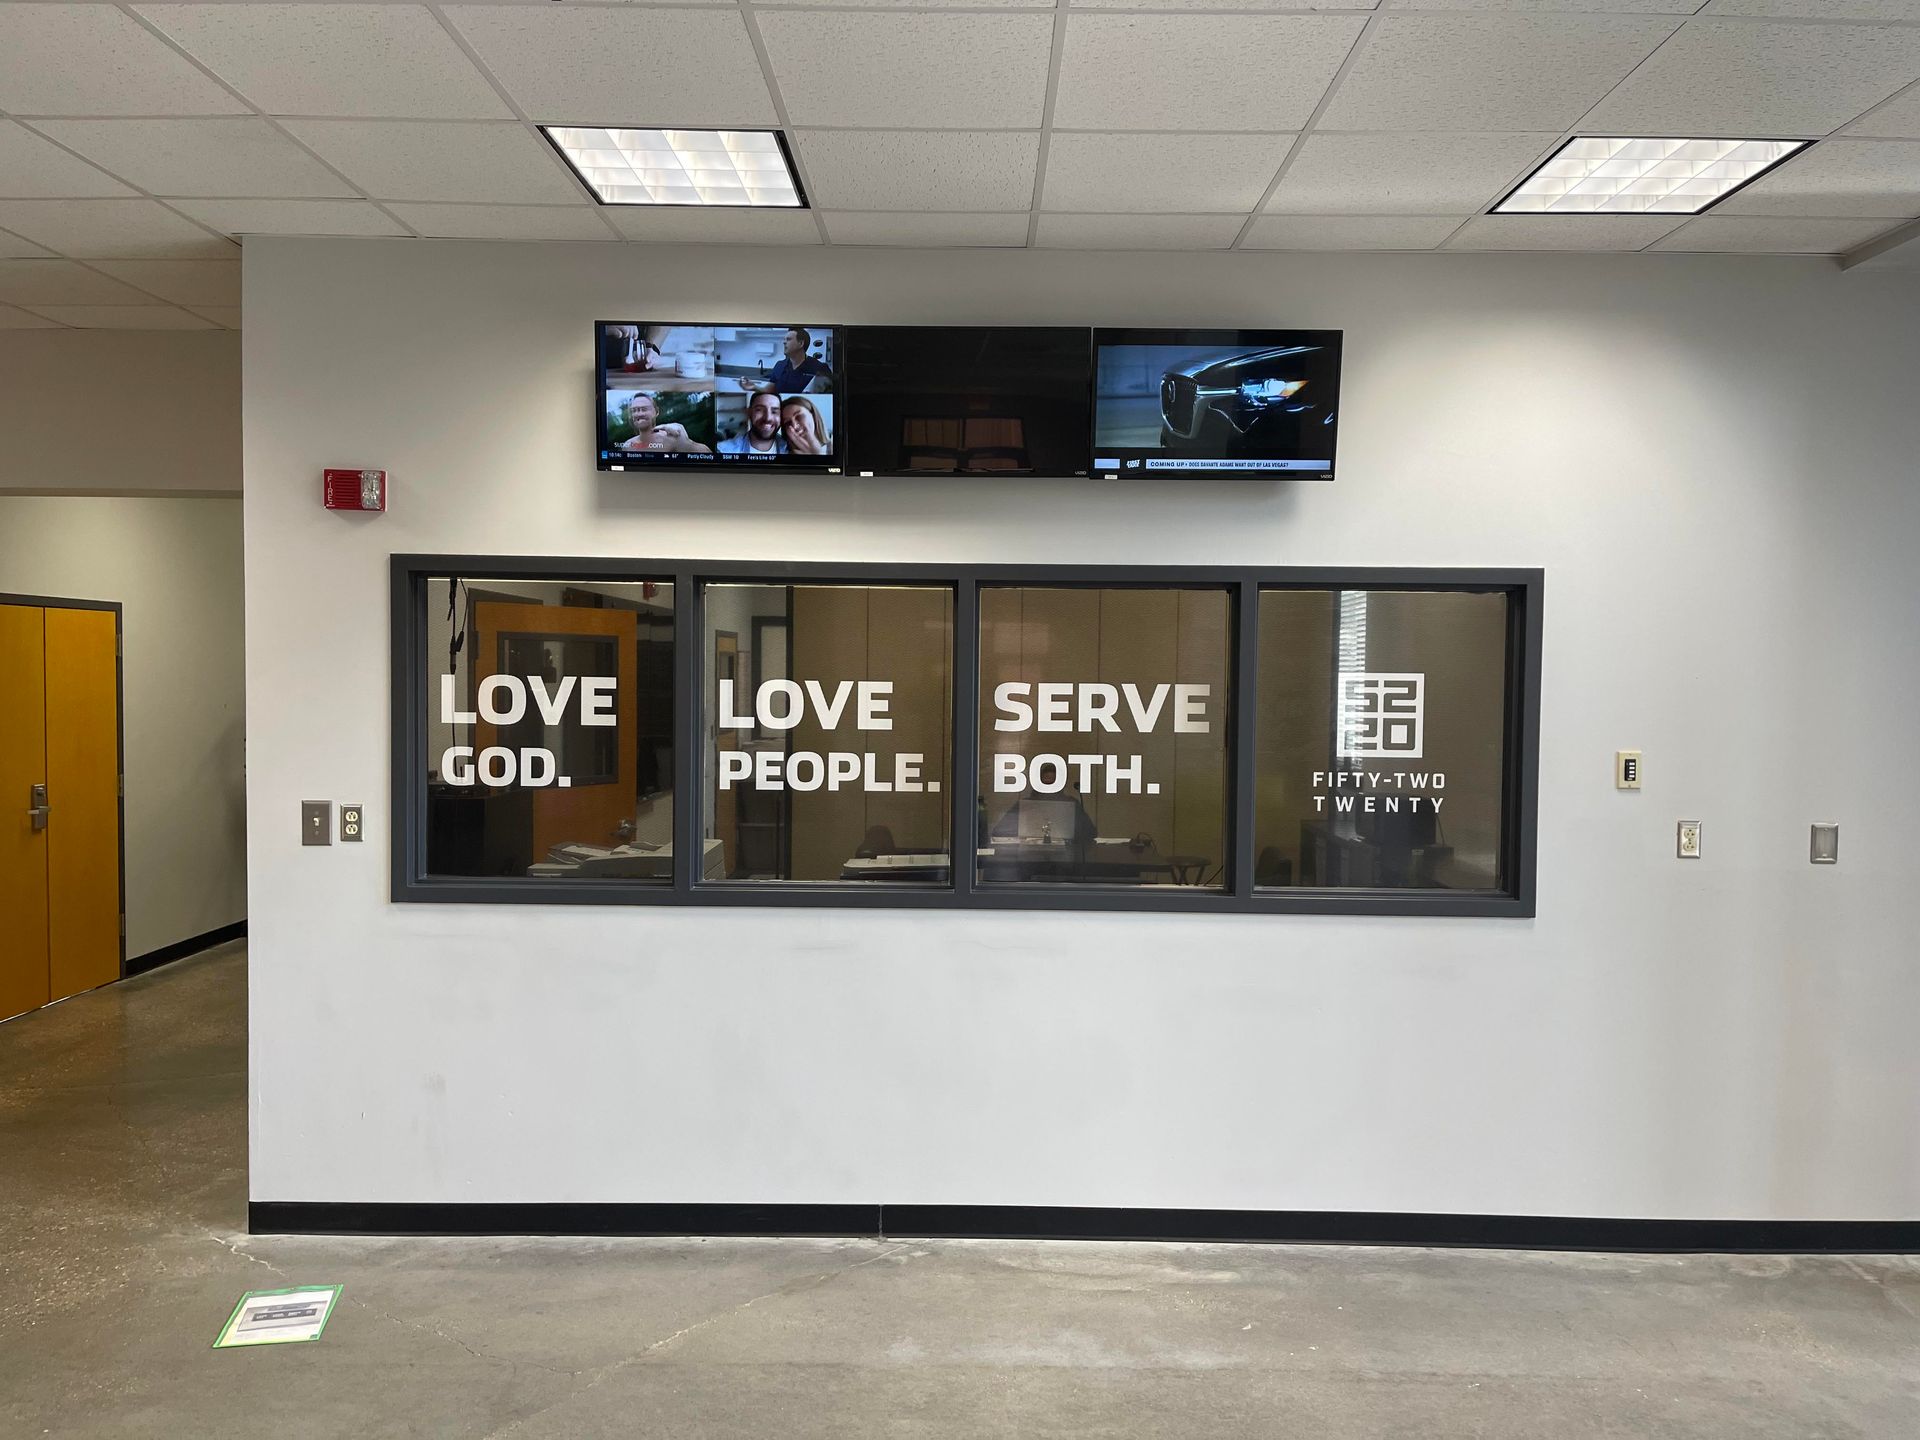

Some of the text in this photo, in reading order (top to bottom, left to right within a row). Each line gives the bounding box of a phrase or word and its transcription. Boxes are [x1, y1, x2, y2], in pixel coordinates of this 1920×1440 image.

[441, 674, 617, 727] LOVE
[719, 678, 894, 731] LOVE
[993, 681, 1211, 733] SERVE
[441, 745, 572, 787] GOD.
[719, 750, 941, 793] PEOPLE.
[993, 753, 1160, 795] BOTH.
[1312, 771, 1445, 789] FIFTY-TWO
[1313, 796, 1444, 814] TWENTY
